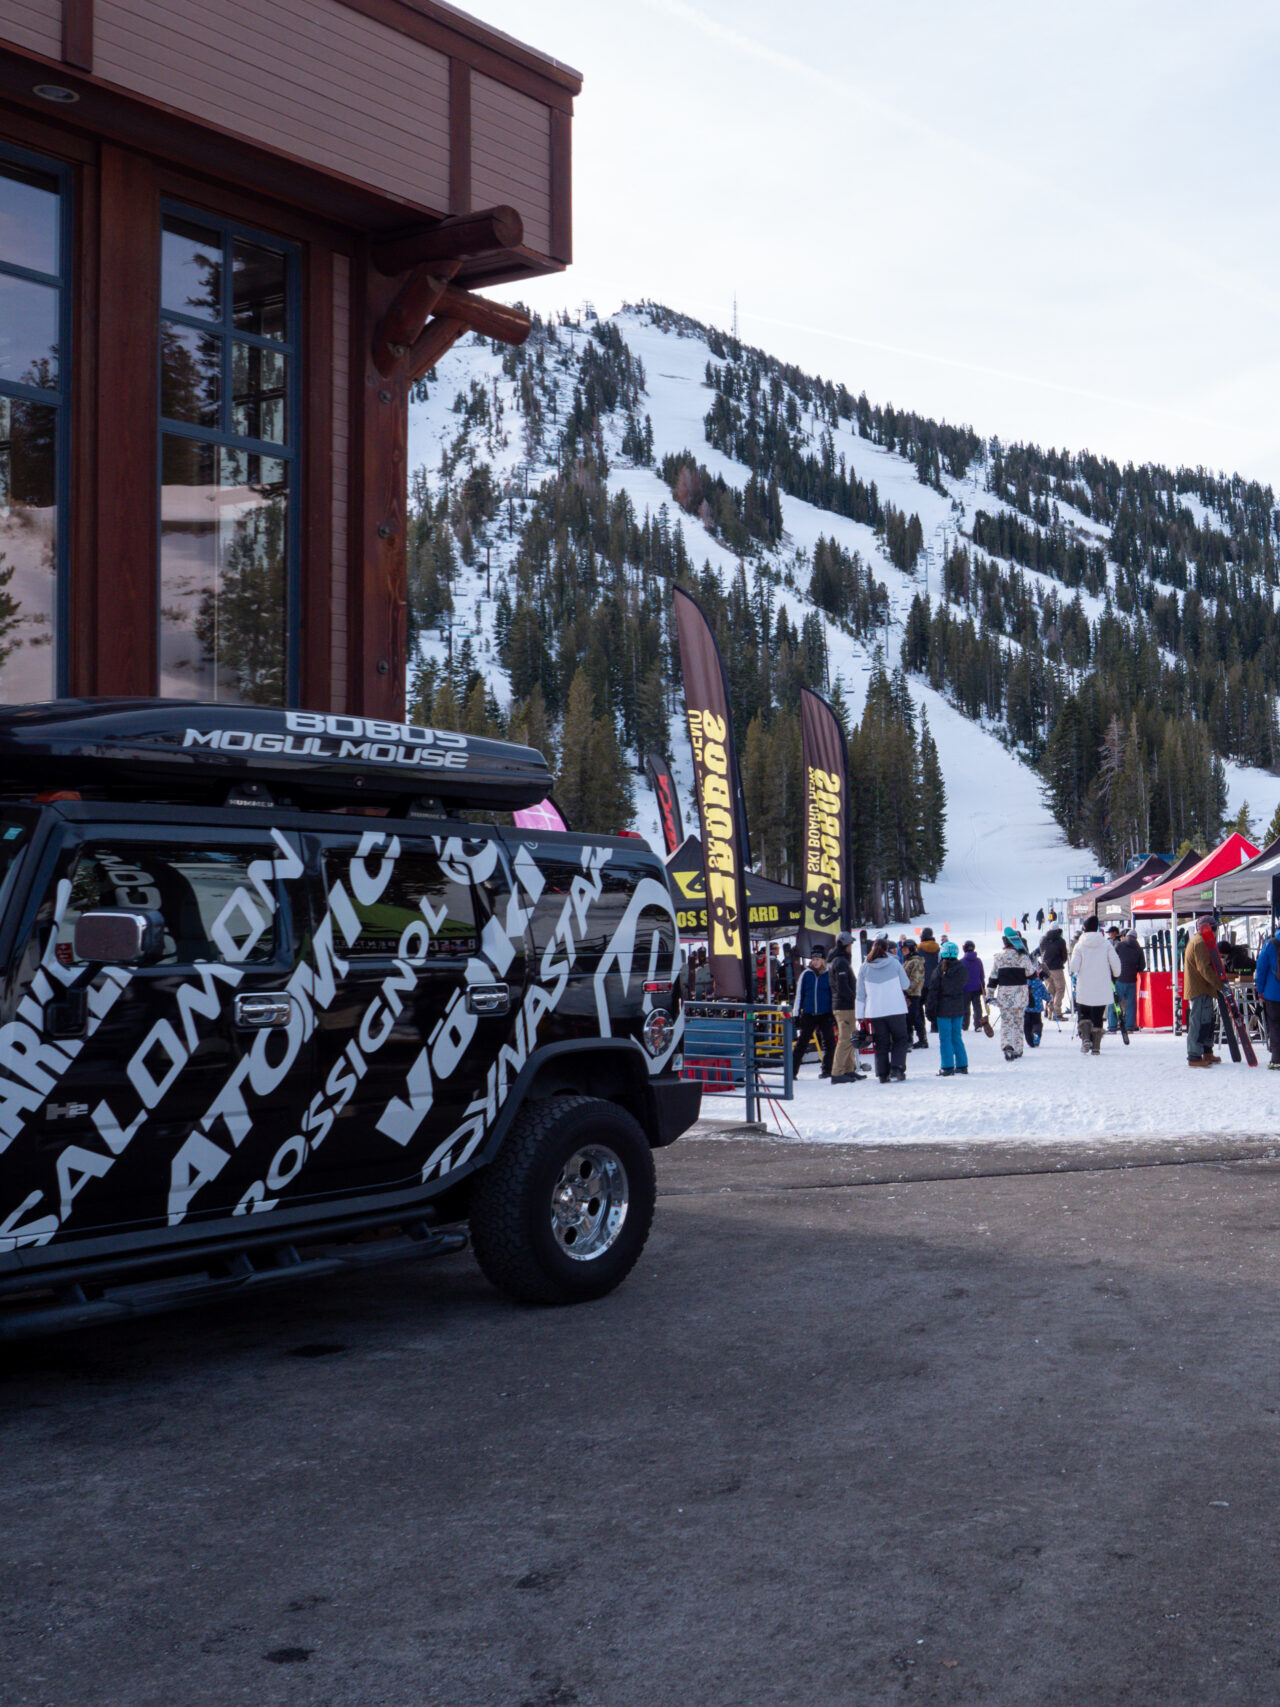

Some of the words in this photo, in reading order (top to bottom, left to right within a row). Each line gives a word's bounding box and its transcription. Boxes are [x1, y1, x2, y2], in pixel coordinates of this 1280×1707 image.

[183, 728, 333, 758] MOGUL
[338, 740, 469, 768] MOUSE
[285, 711, 467, 748] BOBOS
[0, 827, 304, 1251] SALOMON
[46, 1102, 89, 1120] H2
[167, 832, 400, 1227] ATOMIC
[232, 896, 448, 1217] ROSSIGNOL
[421, 846, 613, 1185] DYNASTAR
